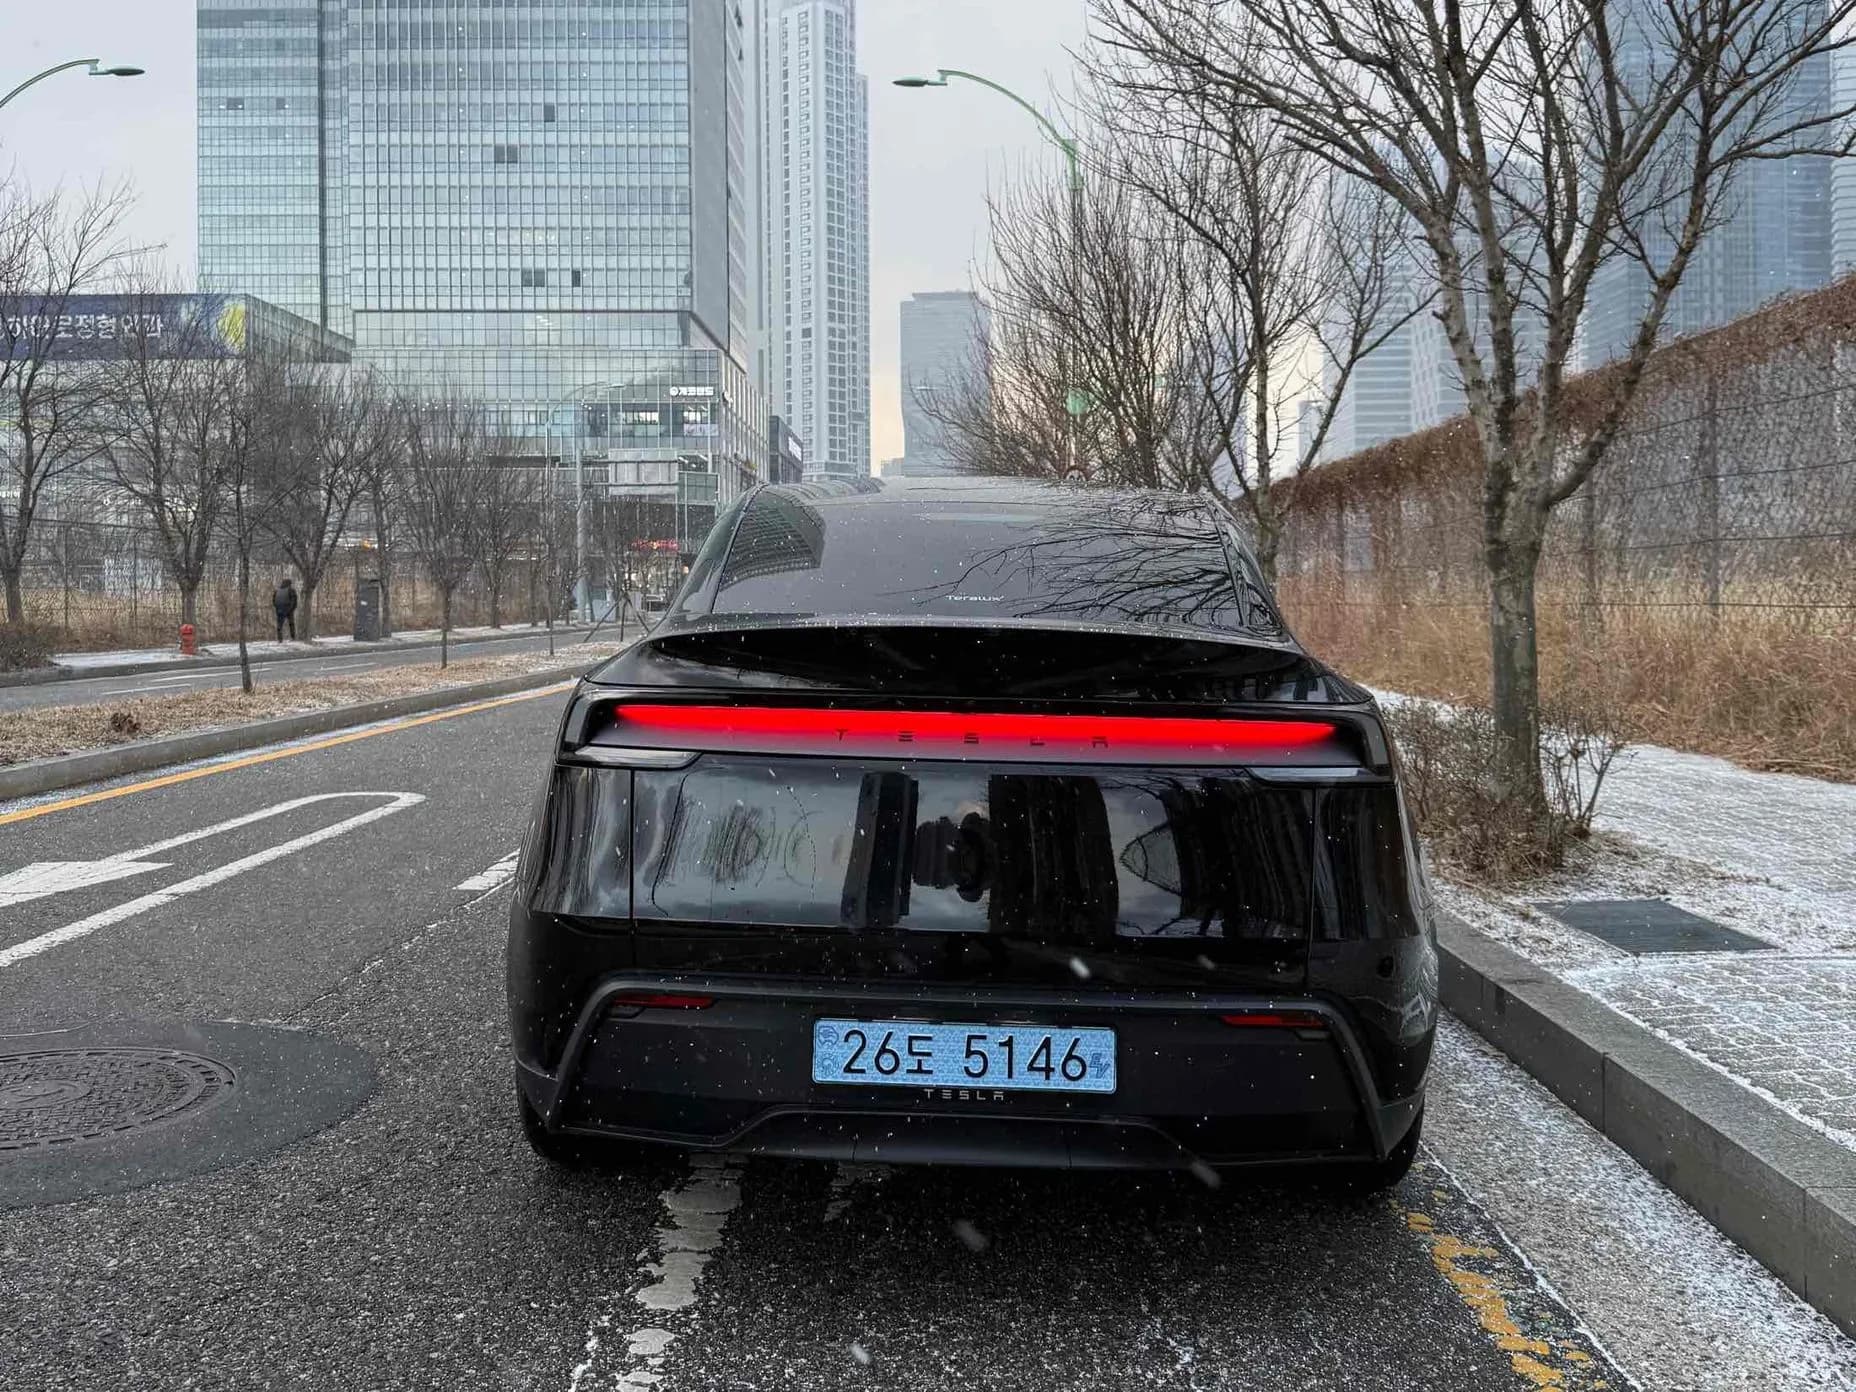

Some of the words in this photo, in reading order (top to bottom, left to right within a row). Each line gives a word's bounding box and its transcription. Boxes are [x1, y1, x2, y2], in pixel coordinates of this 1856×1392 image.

[834, 728, 1109, 749] TESLA
[843, 1029, 934, 1076] 26도
[963, 1034, 1088, 1083] 5146
[923, 1088, 1004, 1101] TESLA
